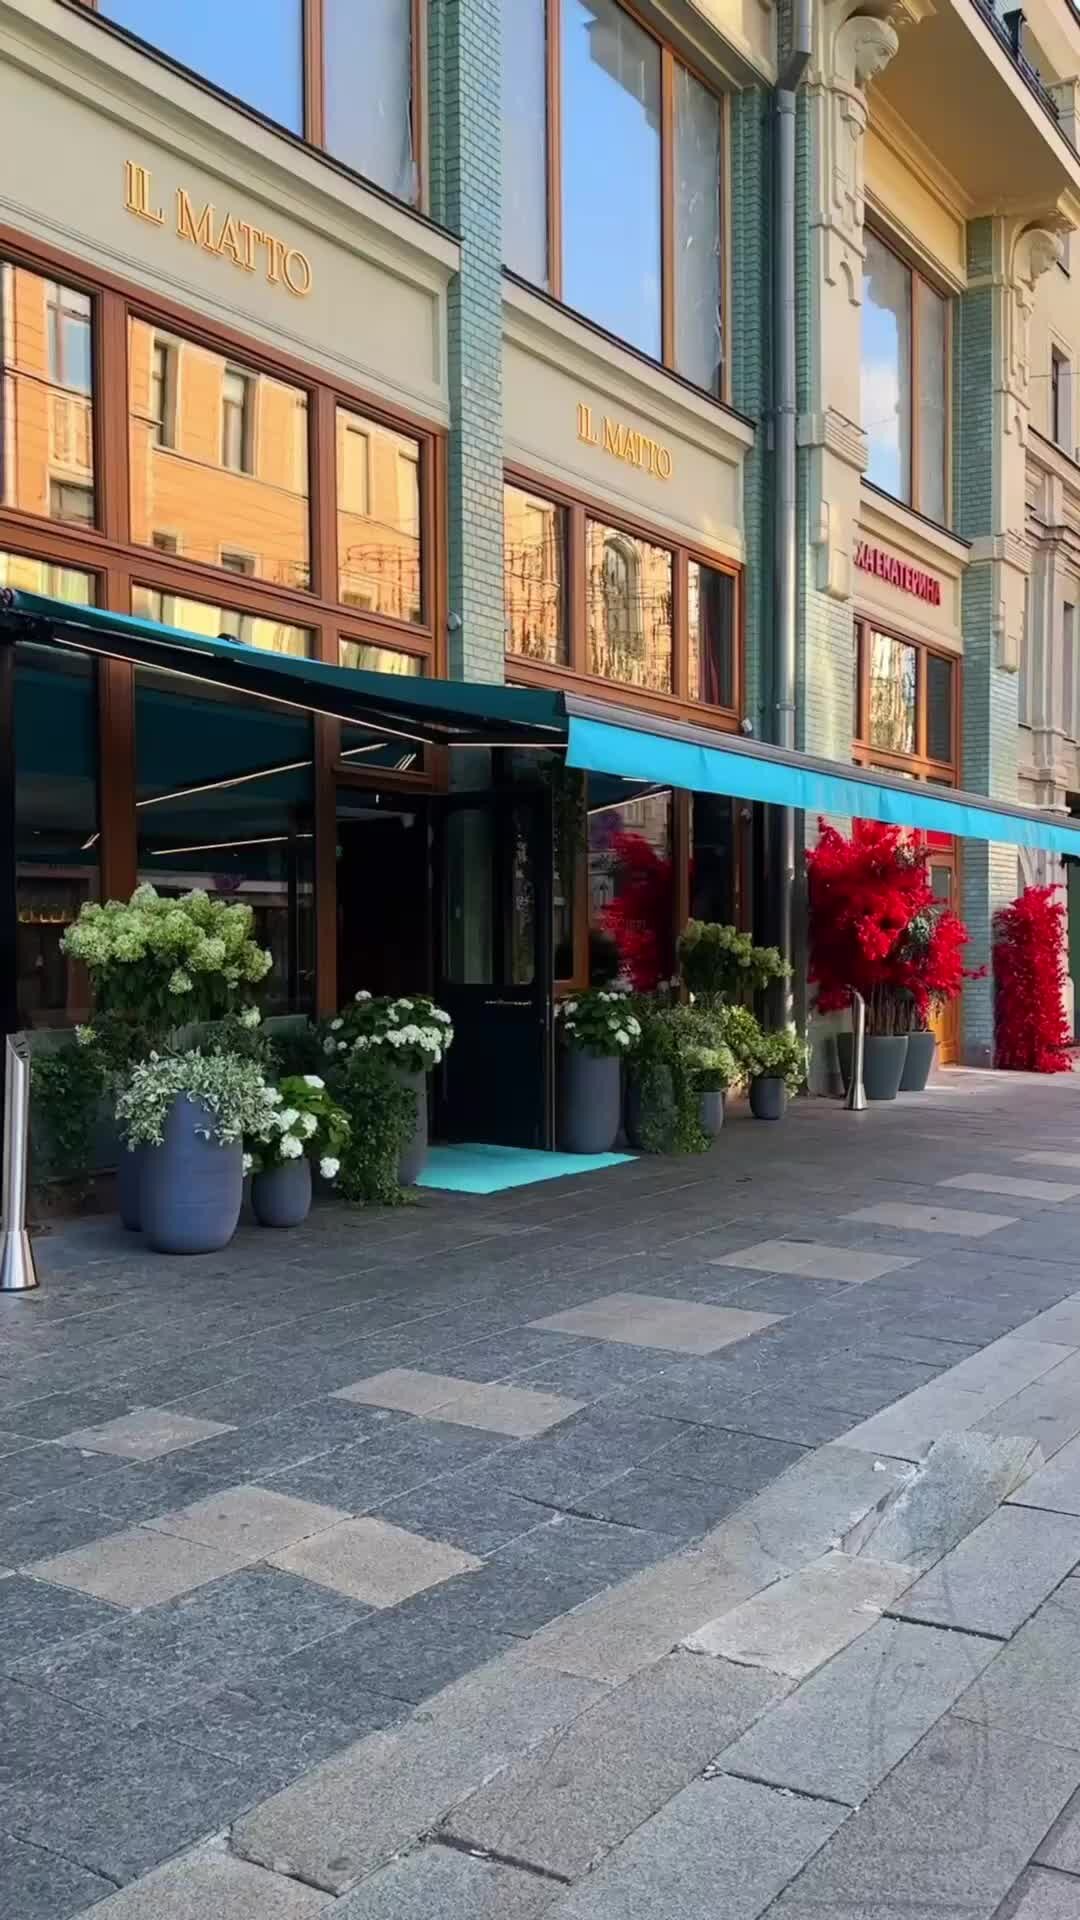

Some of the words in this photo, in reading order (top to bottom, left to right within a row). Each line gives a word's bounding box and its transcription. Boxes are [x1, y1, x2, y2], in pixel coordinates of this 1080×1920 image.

[124, 160, 165, 225] IL
[176, 187, 312, 296] MATTO
[577, 402, 600, 445] IL
[602, 416, 672, 480] MATTO
